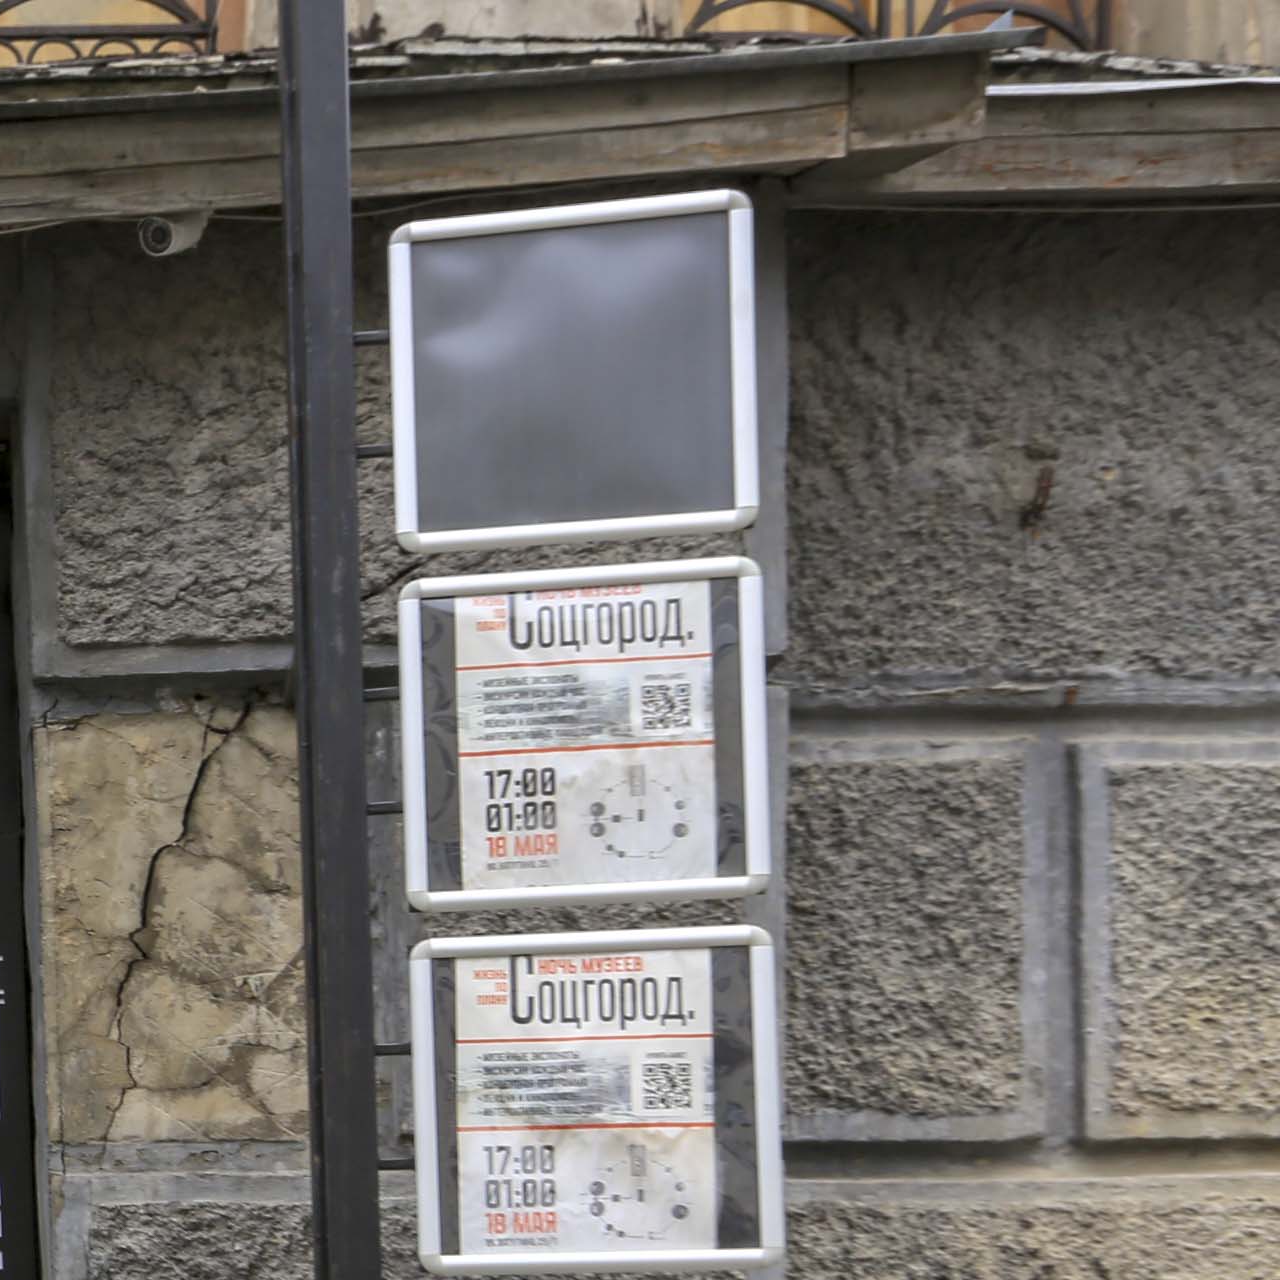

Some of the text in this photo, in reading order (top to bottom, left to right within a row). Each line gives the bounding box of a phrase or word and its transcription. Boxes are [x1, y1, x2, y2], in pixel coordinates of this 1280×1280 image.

[484, 767, 556, 799] 17:00
[486, 801, 557, 832] 01:00
[486, 833, 559, 858] 18 МАЯ
[538, 956, 644, 974] НОЧЬ МУЗЕЕВ
[483, 1145, 555, 1175] 17:00
[485, 1179, 556, 1209] 01:00
[485, 1211, 559, 1234] 18 МАЯ
